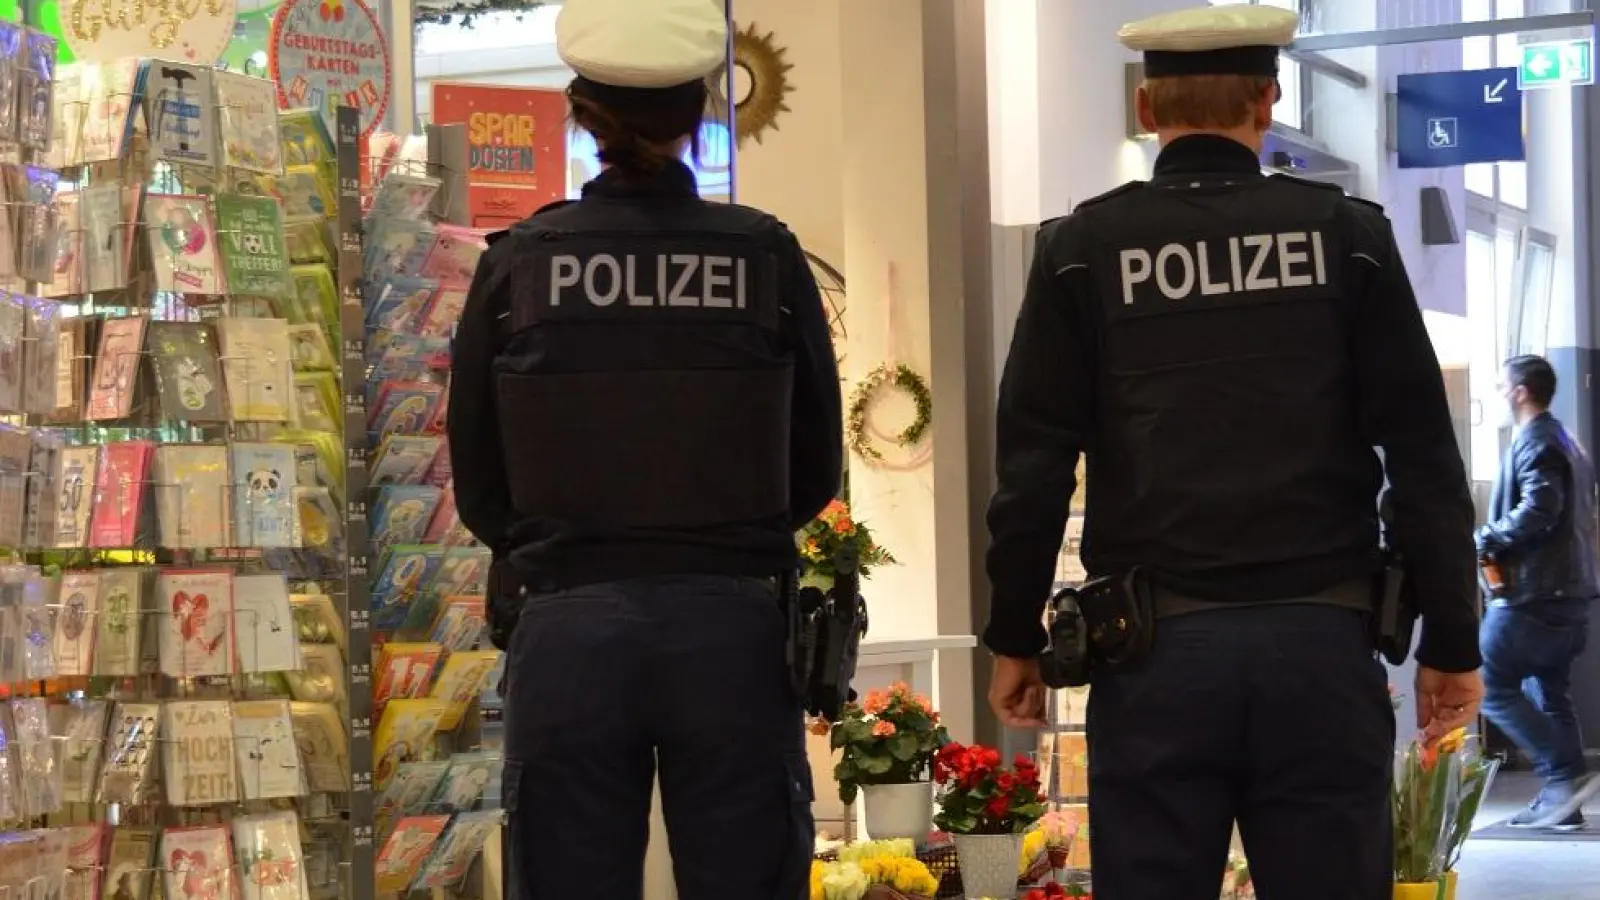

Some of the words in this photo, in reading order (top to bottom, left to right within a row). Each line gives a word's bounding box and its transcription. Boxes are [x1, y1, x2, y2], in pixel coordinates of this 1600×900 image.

[283, 32, 381, 60] GEBURTSTAGS-
[307, 55, 360, 75] KARTEN
[469, 112, 535, 147] SPAR
[469, 145, 535, 173] DOSEN
[550, 252, 747, 310] POLIZEI
[1120, 231, 1327, 305] POLIZEI
